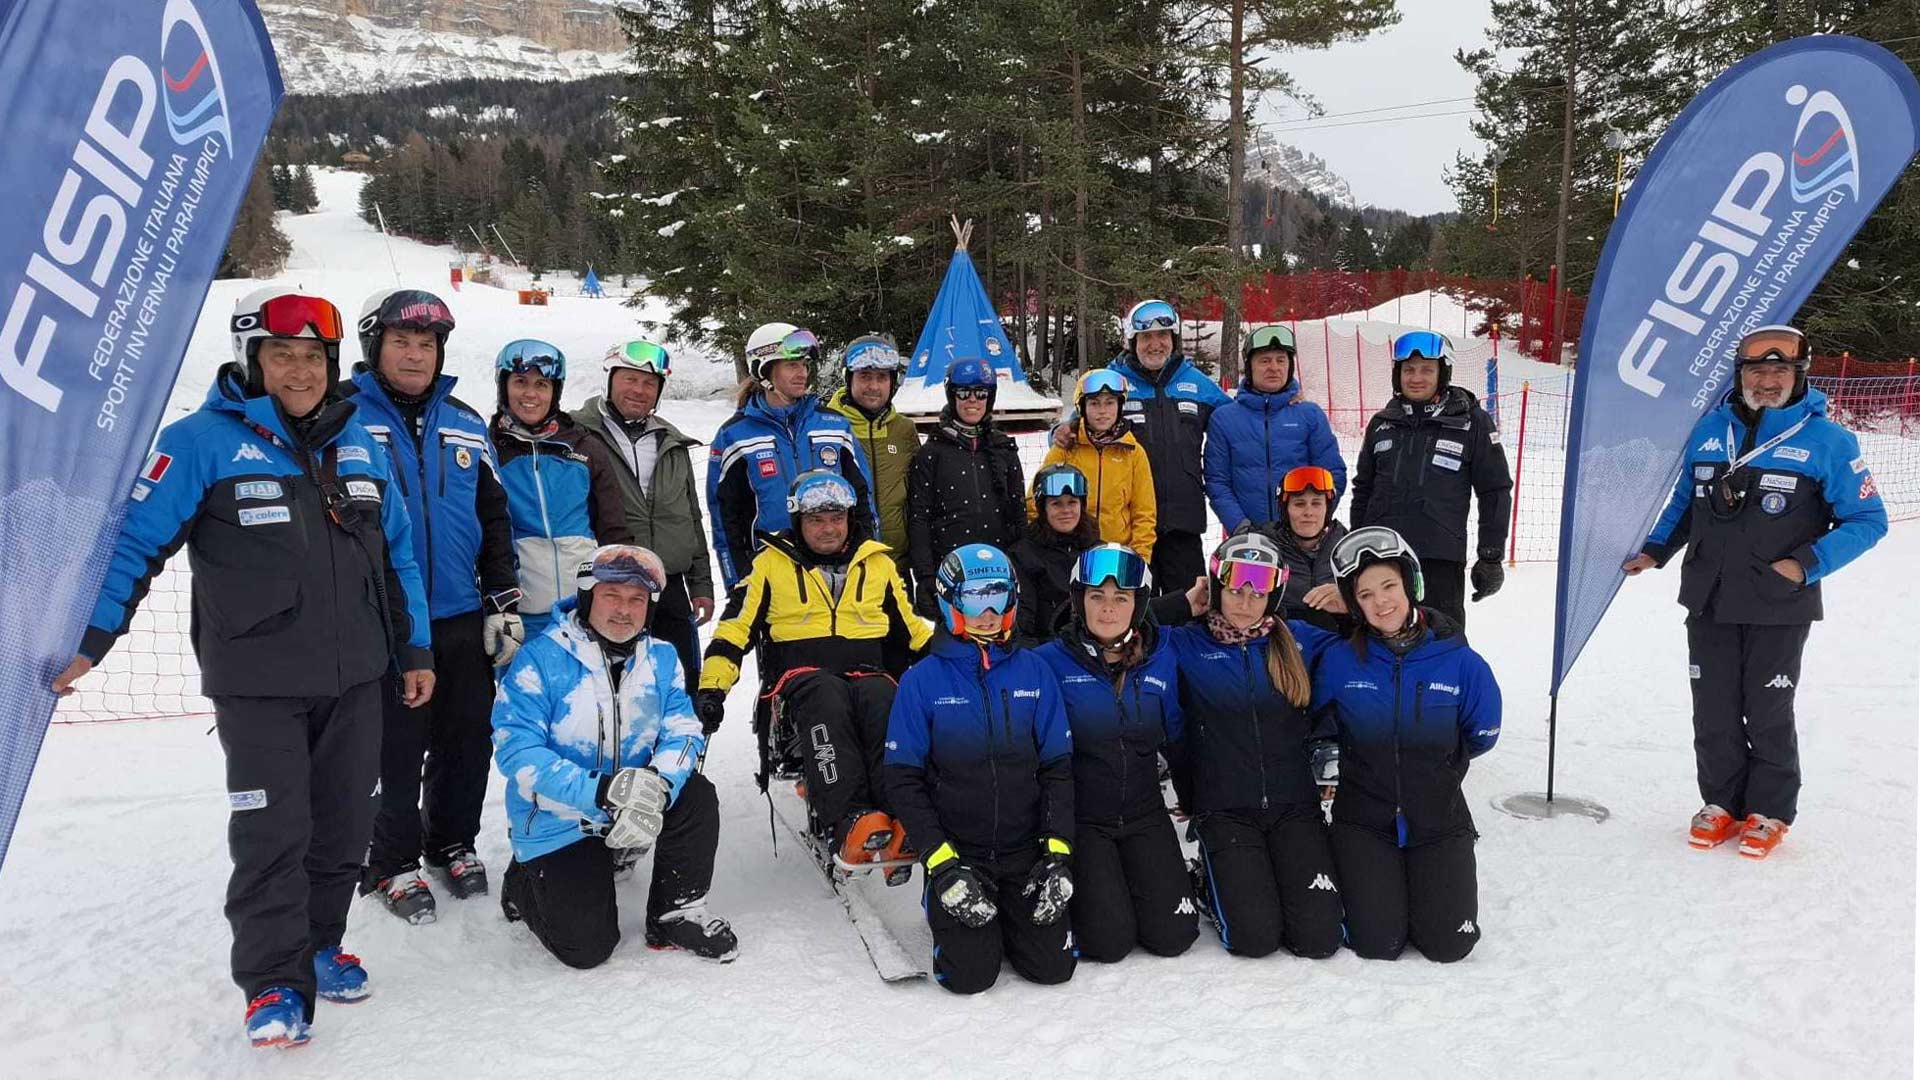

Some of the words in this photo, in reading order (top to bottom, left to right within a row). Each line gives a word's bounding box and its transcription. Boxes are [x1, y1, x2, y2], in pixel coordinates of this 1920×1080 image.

[0, 55, 157, 413] FISIP
[88, 236, 154, 381] FEDERAZIONE
[143, 153, 188, 239] ITALIANA
[97, 359, 136, 432] SPORT
[125, 253, 177, 360] INVERNALI
[166, 136, 221, 255] PARALIMPICI
[1618, 152, 1785, 397] FISIP
[1689, 275, 1761, 376] FEDERAZIONE
[1754, 211, 1808, 275] ITALIANA
[1691, 360, 1728, 410] SPORT
[1774, 190, 1845, 283] PARALIMPICI
[811, 723, 838, 785] CMP
